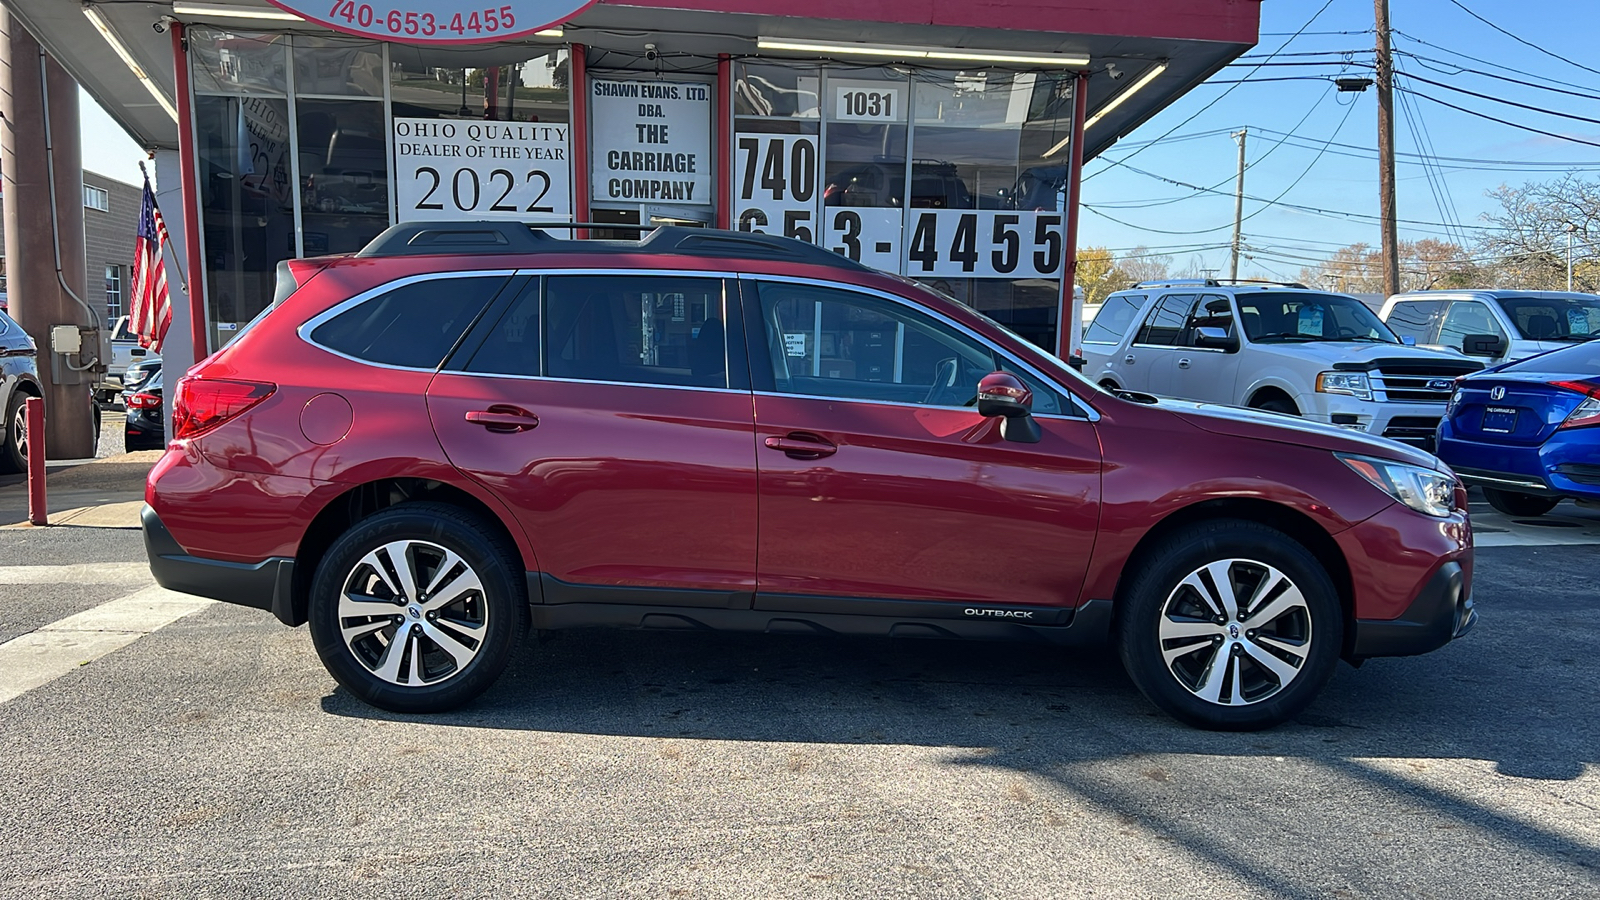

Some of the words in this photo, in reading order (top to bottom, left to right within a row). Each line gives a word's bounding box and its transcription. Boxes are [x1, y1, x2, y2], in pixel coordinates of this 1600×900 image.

[329, 0, 515, 36] 740-653-4455
[594, 82, 638, 97] SHAWN
[641, 84, 681, 99] EVANS.
[686, 87, 709, 101] LTD.
[638, 103, 666, 118] DBA.
[843, 92, 892, 117] 1031
[396, 122, 456, 138] OHIO
[467, 125, 567, 142] QUALITY
[635, 123, 669, 144] THE
[399, 142, 461, 157] DEALER
[465, 145, 486, 158] OF
[490, 146, 521, 159] THE
[524, 147, 565, 161] YEAR
[607, 150, 696, 173] CARRIAGE
[738, 137, 815, 202] 740
[414, 166, 554, 213] 2022
[608, 178, 696, 201] COMPANY
[964, 608, 1034, 619] OUTBACK
